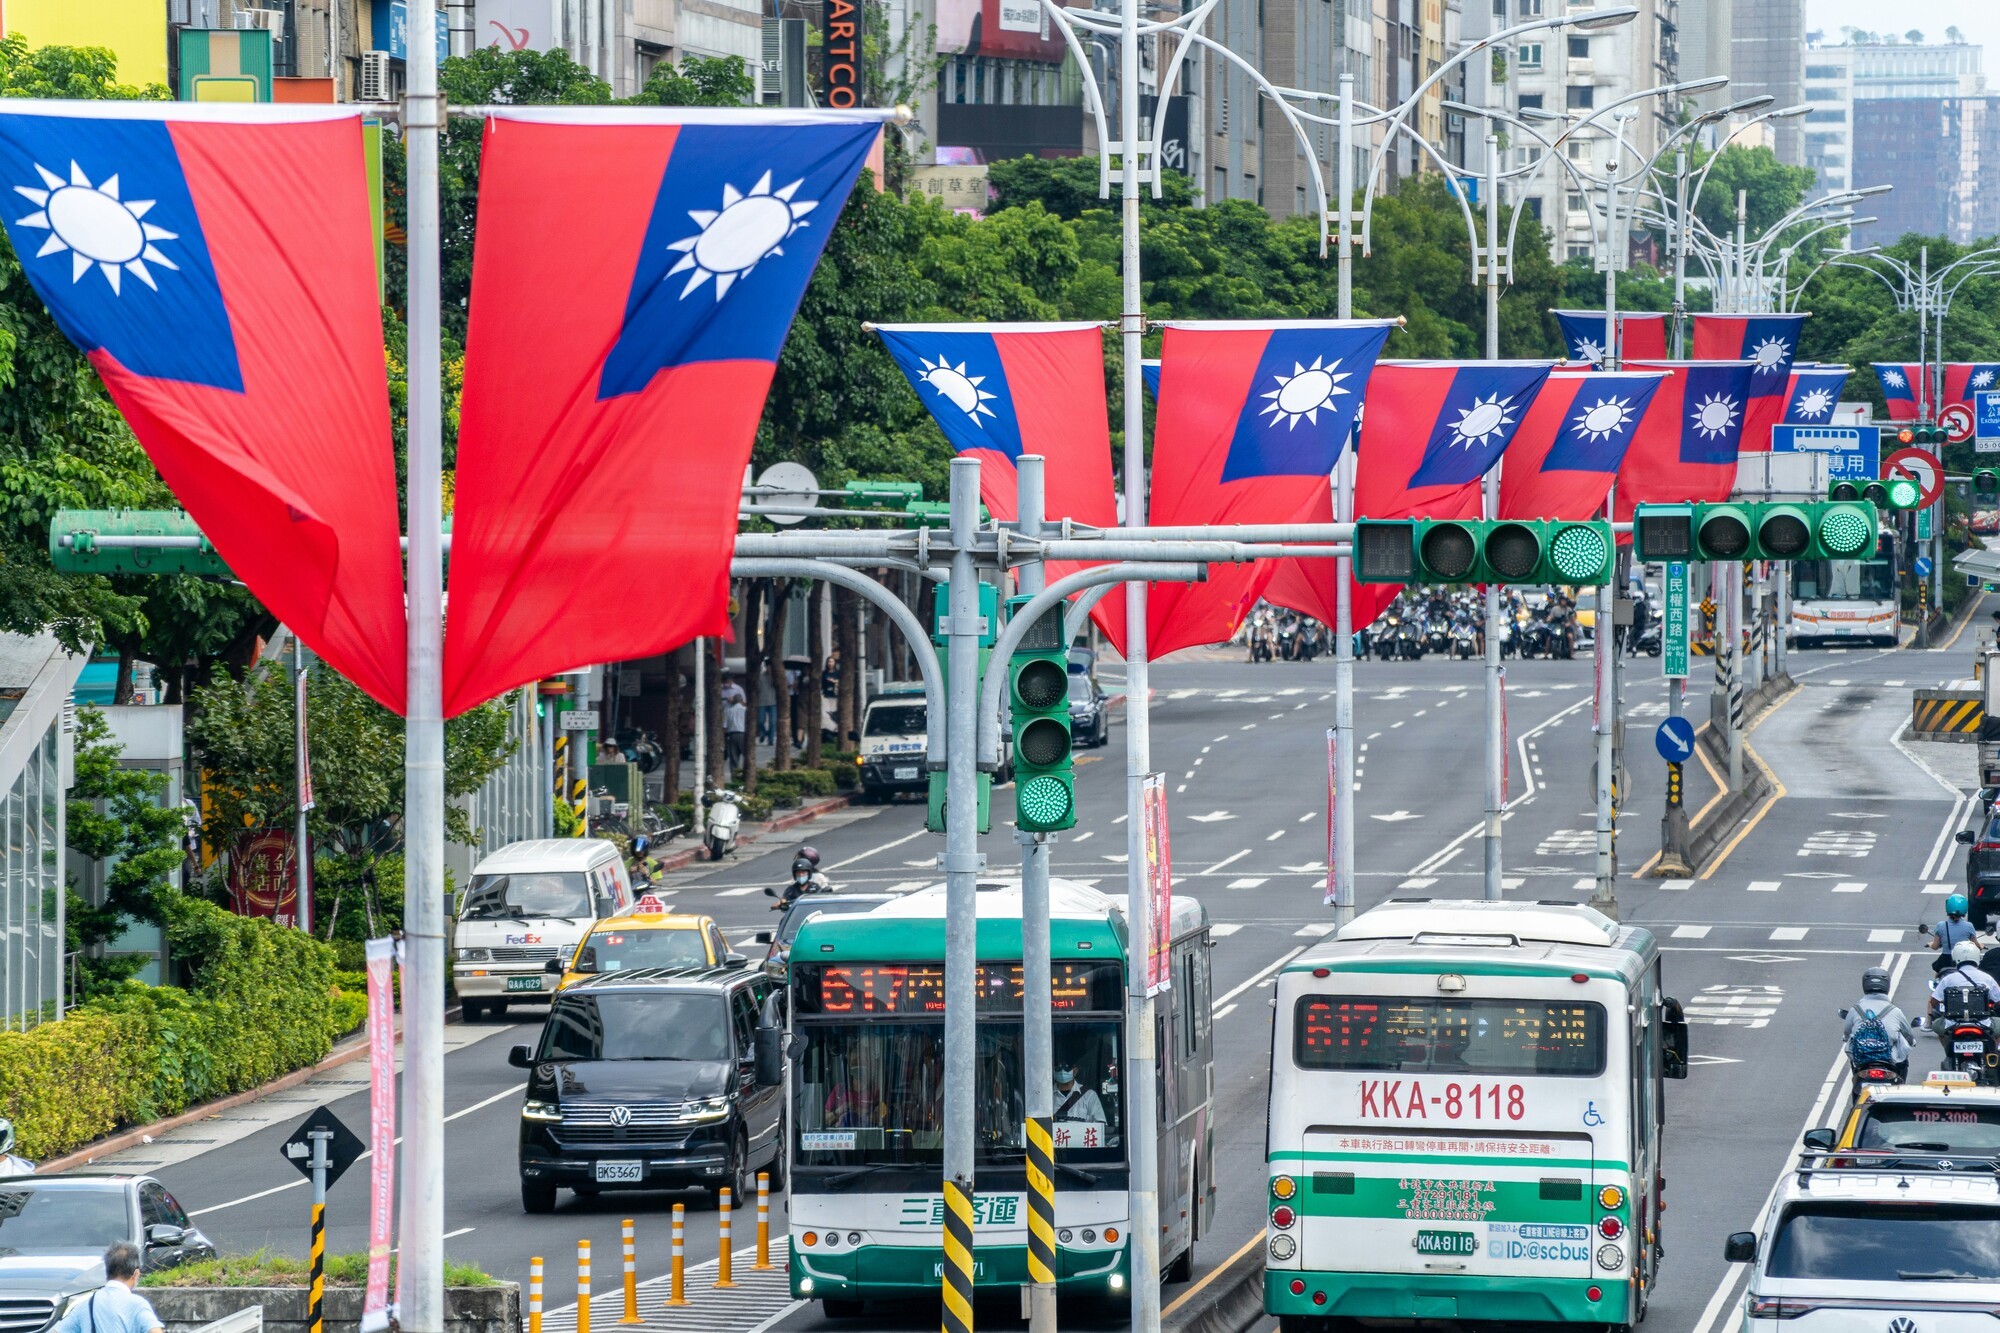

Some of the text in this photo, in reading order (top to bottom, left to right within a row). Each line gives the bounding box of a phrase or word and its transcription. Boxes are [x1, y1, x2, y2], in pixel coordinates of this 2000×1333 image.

[1829, 455, 1864, 473] 專用
[1669, 578, 1683, 637] 民權西路
[505, 933, 542, 945] FedEx
[1360, 1080, 1526, 1121] KKA-8118
[1913, 1110, 1978, 1124] TDP-3080
[1054, 1126, 1098, 1148] 新莊
[1414, 1189, 1479, 1200] 27291181
[1405, 1208, 1487, 1221] 0800090607
